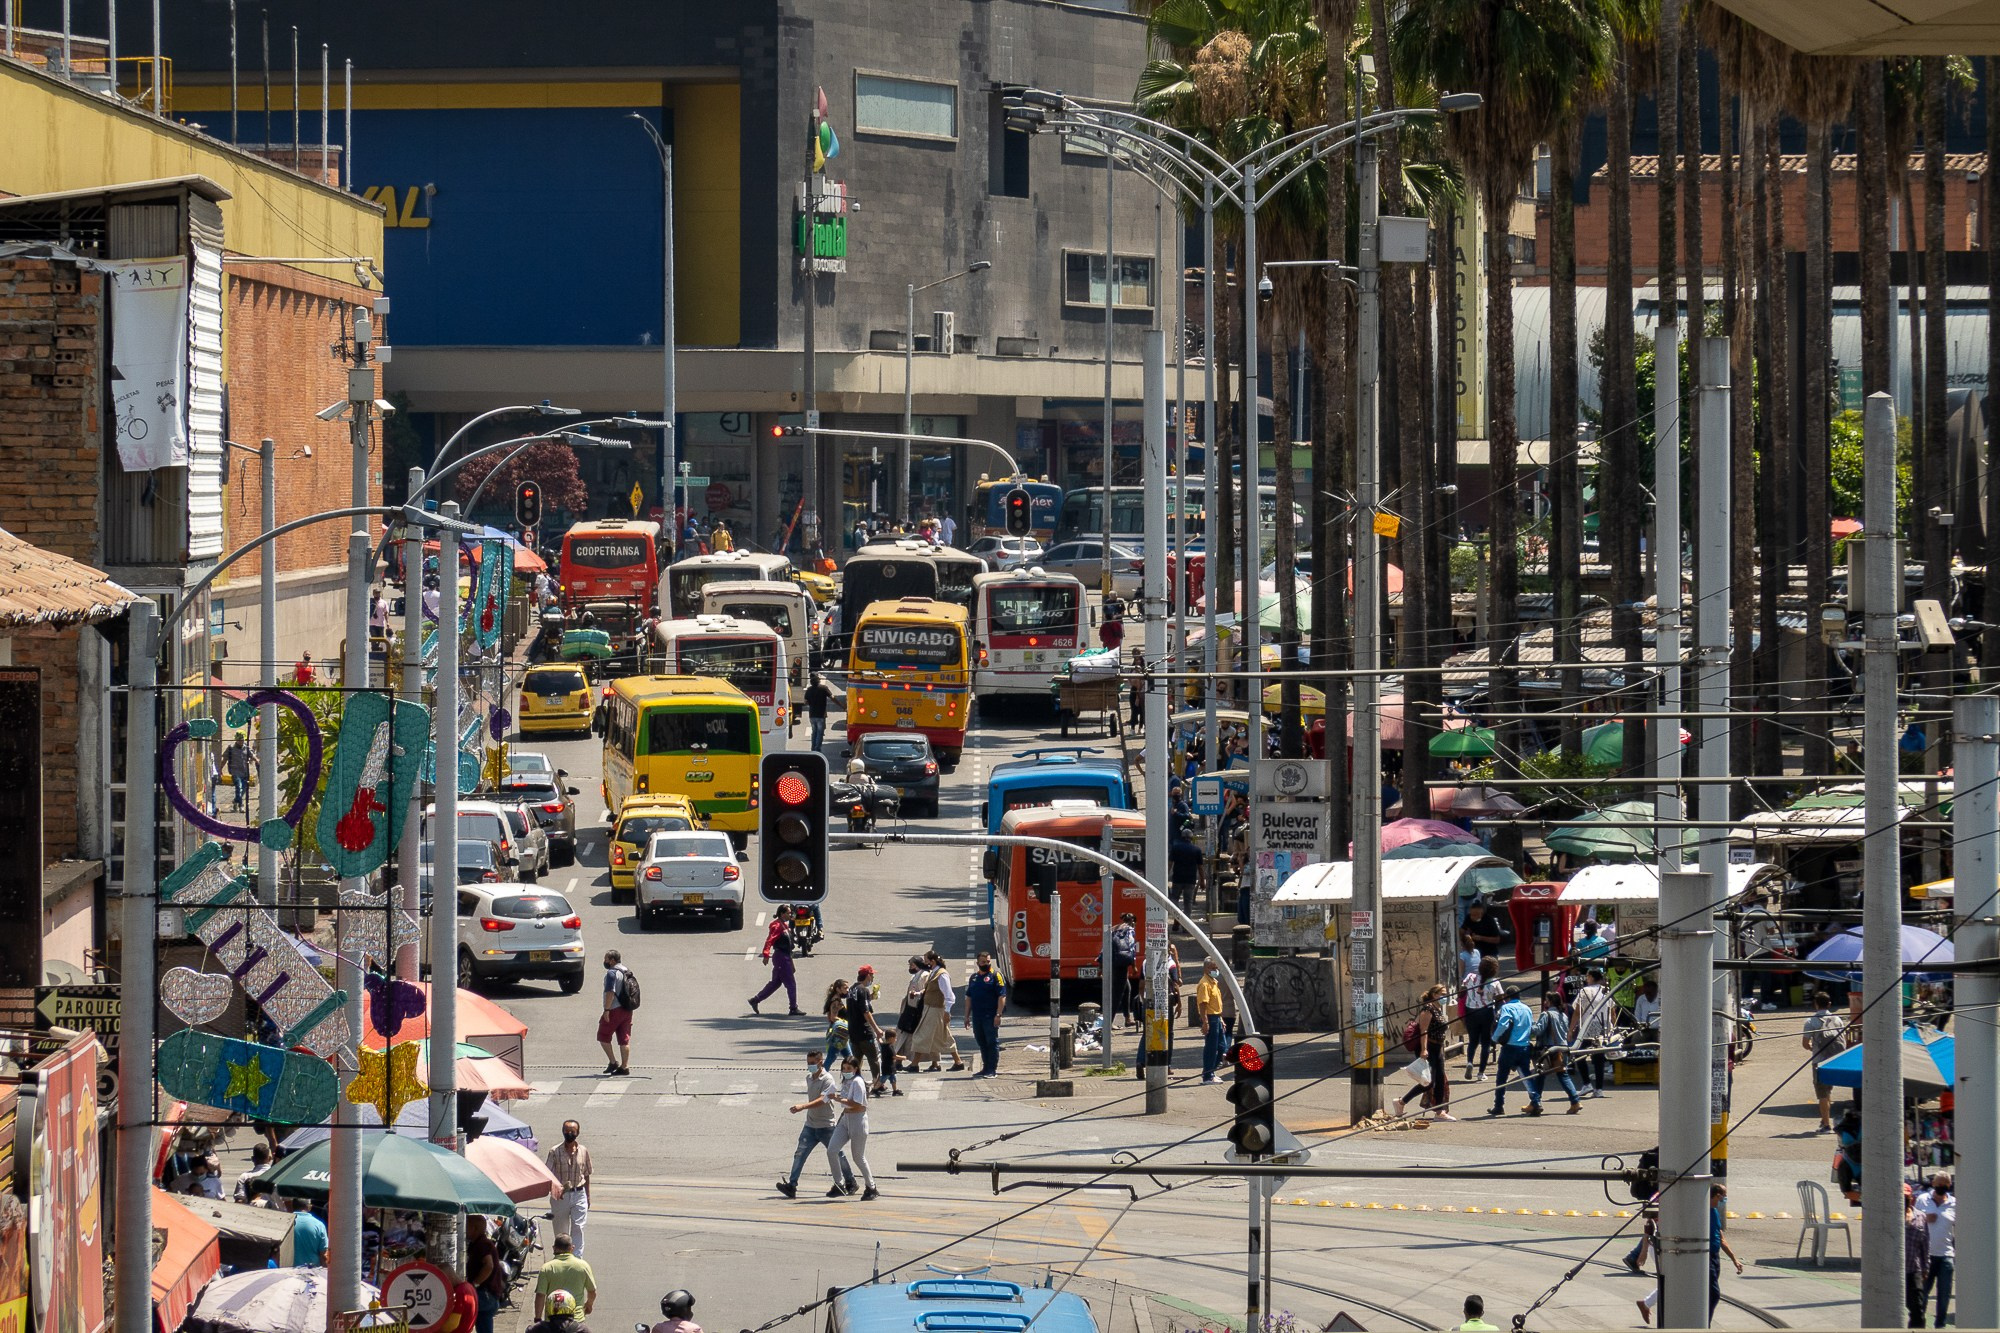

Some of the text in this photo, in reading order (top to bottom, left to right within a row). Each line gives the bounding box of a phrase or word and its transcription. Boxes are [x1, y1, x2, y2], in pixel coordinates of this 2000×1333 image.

[1455, 247, 1467, 396] Antonio
[155, 379, 175, 387] PESAS
[576, 546, 640, 556] COOPETRANSA
[863, 630, 955, 646] ENVIGADO
[1052, 638, 1073, 647] 4626
[1262, 812, 1319, 828] Bulevar
[1262, 828, 1318, 840] Artesanal
[1266, 841, 1314, 849] San Antonio
[58, 1018, 121, 1032] ABIERTO
